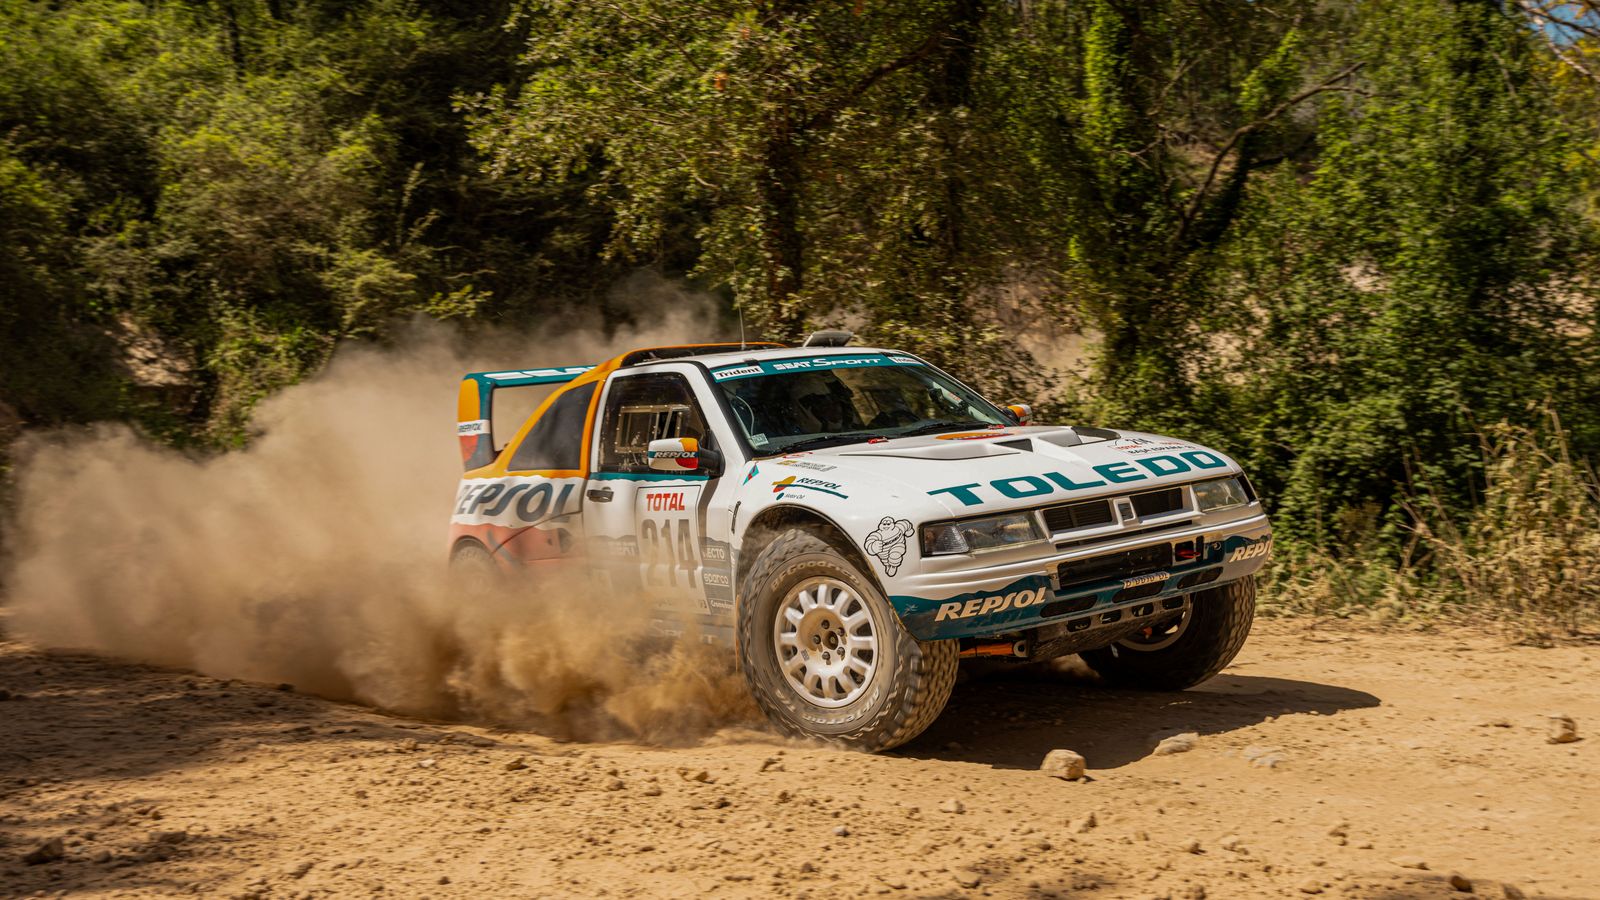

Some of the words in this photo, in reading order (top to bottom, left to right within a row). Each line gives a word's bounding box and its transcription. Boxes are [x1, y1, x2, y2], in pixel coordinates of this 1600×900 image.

[716, 367, 760, 378] Trident
[773, 362, 810, 370] SEAT
[797, 477, 842, 490] REPSOL
[926, 451, 1227, 506] TOLEDO
[646, 493, 685, 512] TOTAL
[641, 519, 699, 588] 214
[704, 573, 729, 585] sparco
[934, 586, 1047, 622] REPSOL
